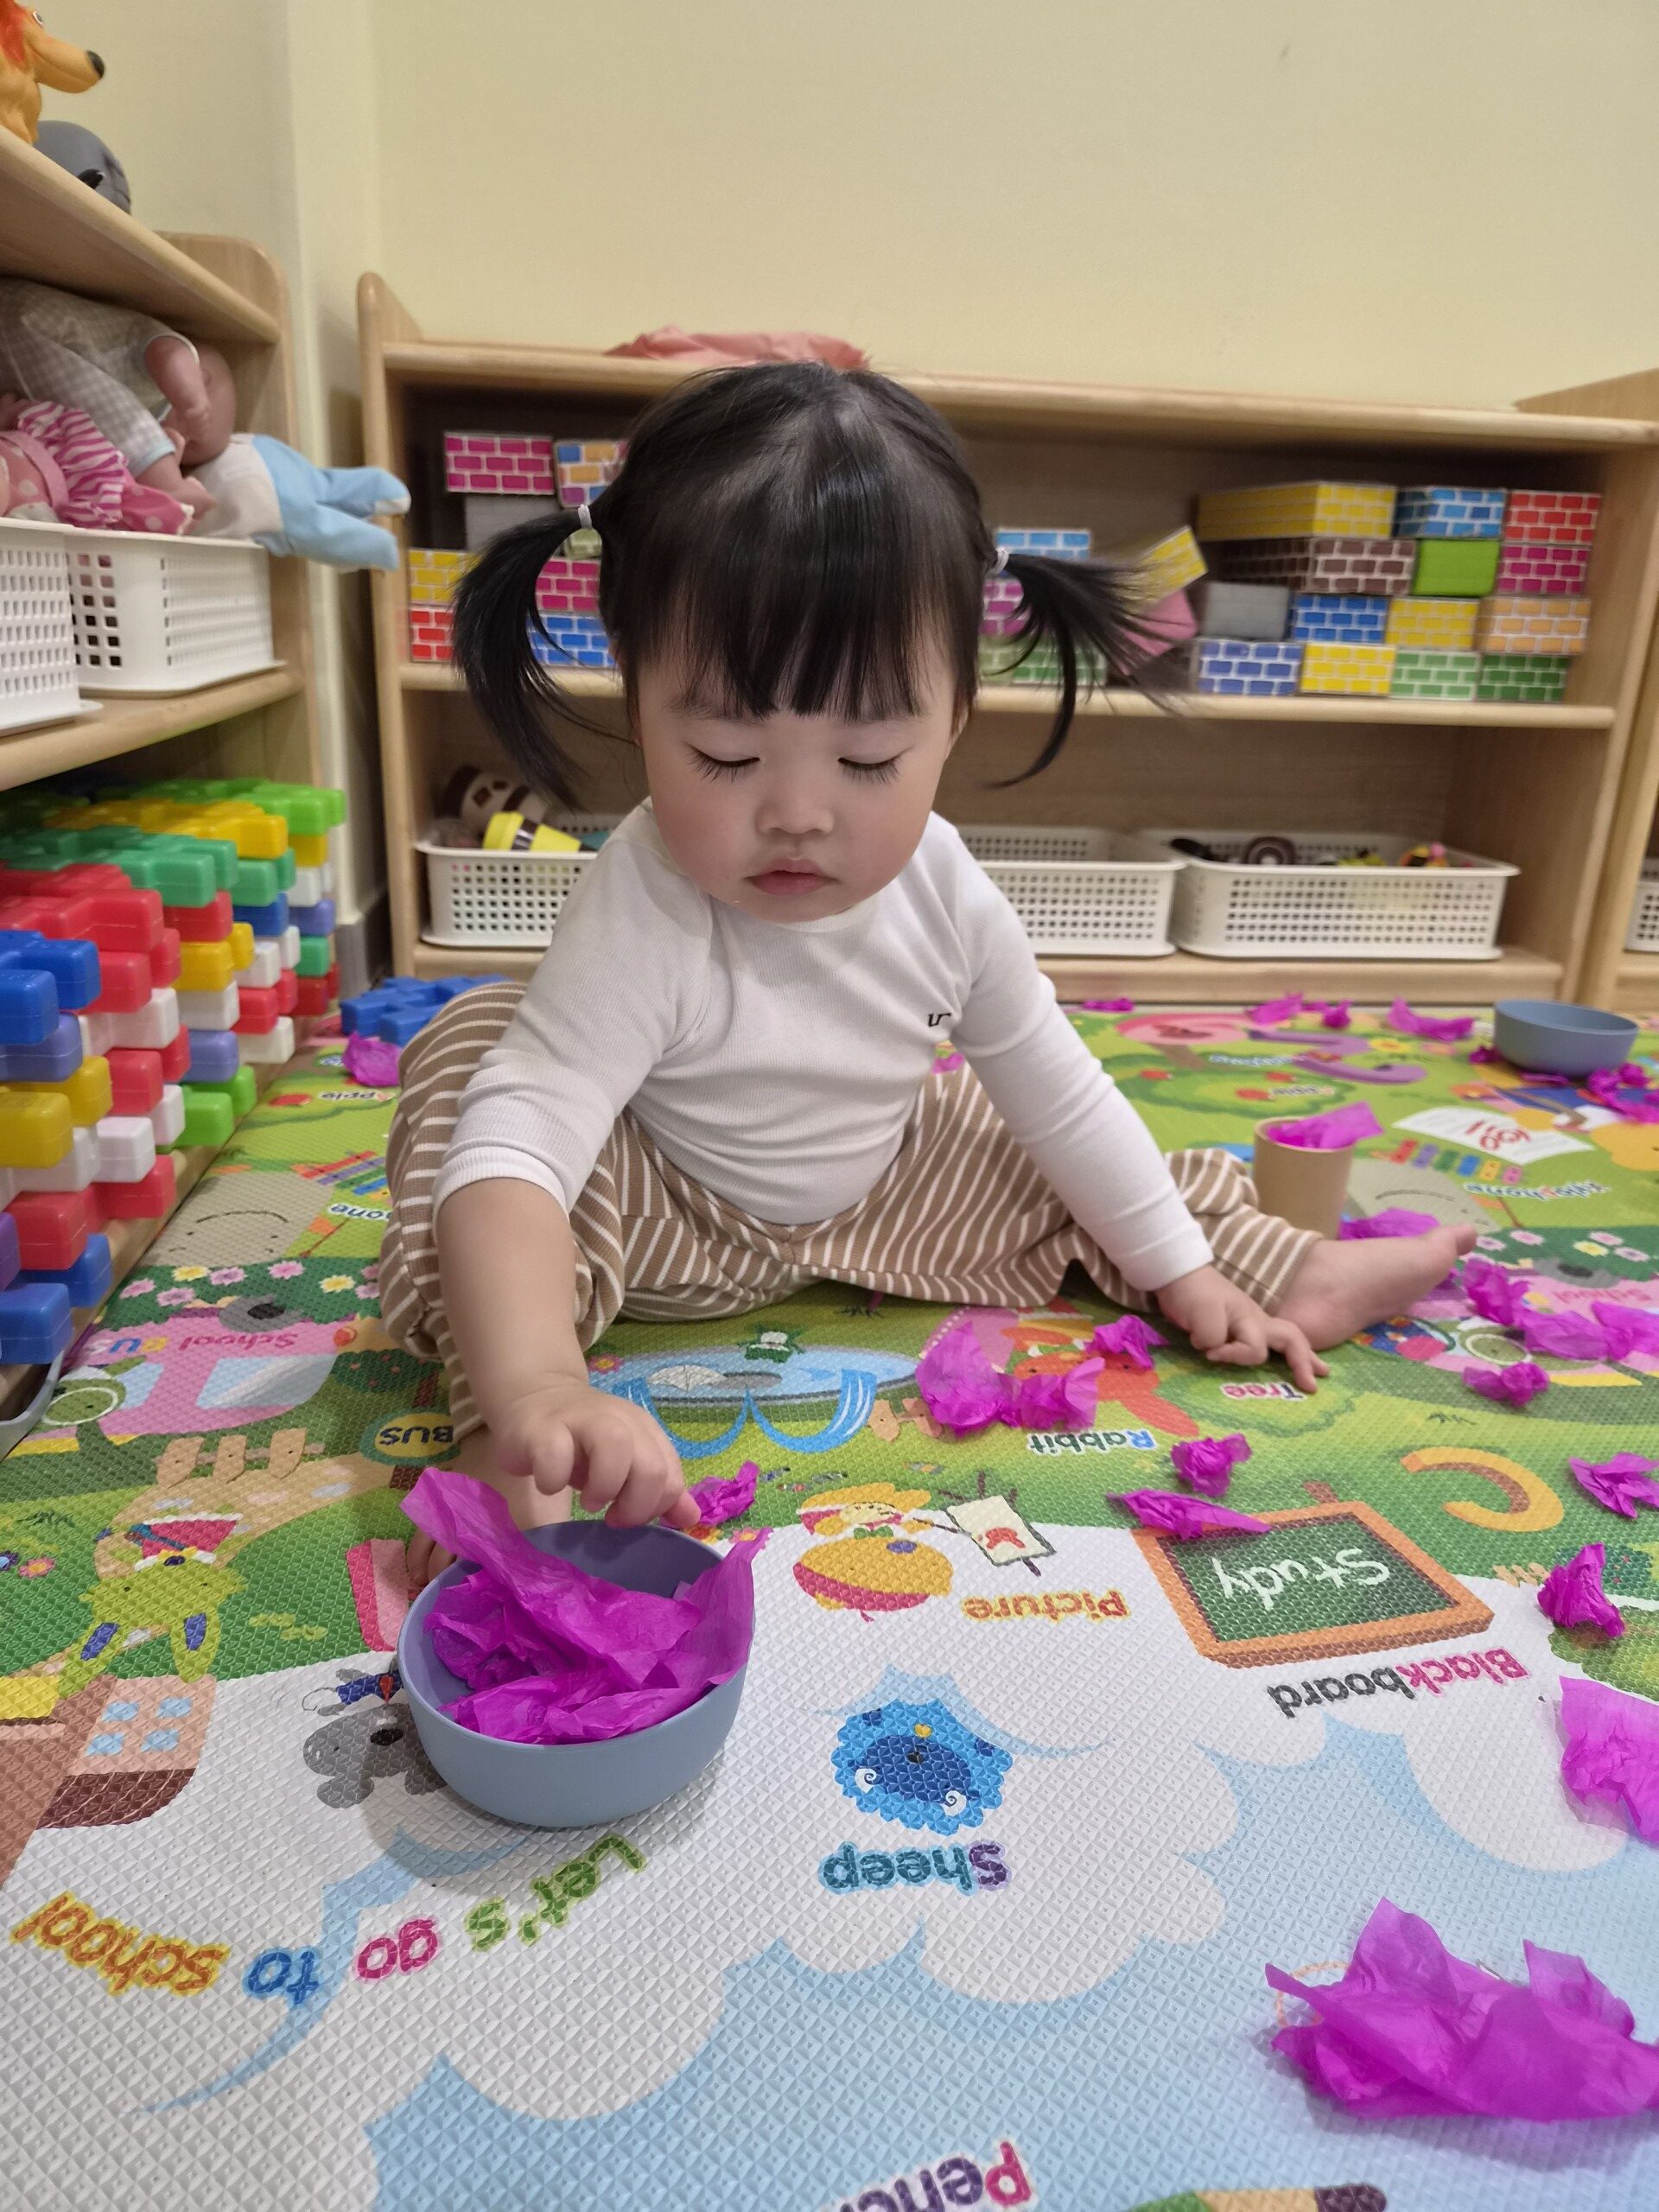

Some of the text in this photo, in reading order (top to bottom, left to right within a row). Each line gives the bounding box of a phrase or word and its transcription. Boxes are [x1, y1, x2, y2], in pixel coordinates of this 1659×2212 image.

[179, 1332, 298, 1351] School
[1223, 1382, 1305, 1401] Tree
[378, 1426, 454, 1446] BUS
[1027, 1430, 1155, 1452] Rabbit
[1211, 1548, 1390, 1611] Study
[966, 1592, 1130, 1621] Picture
[1268, 1648, 1529, 1719] Blackboard
[822, 1840, 1009, 1892] Sheep
[357, 1916, 441, 1981] go
[242, 1948, 320, 2004] to
[840, 2141, 1032, 2212] Penc
